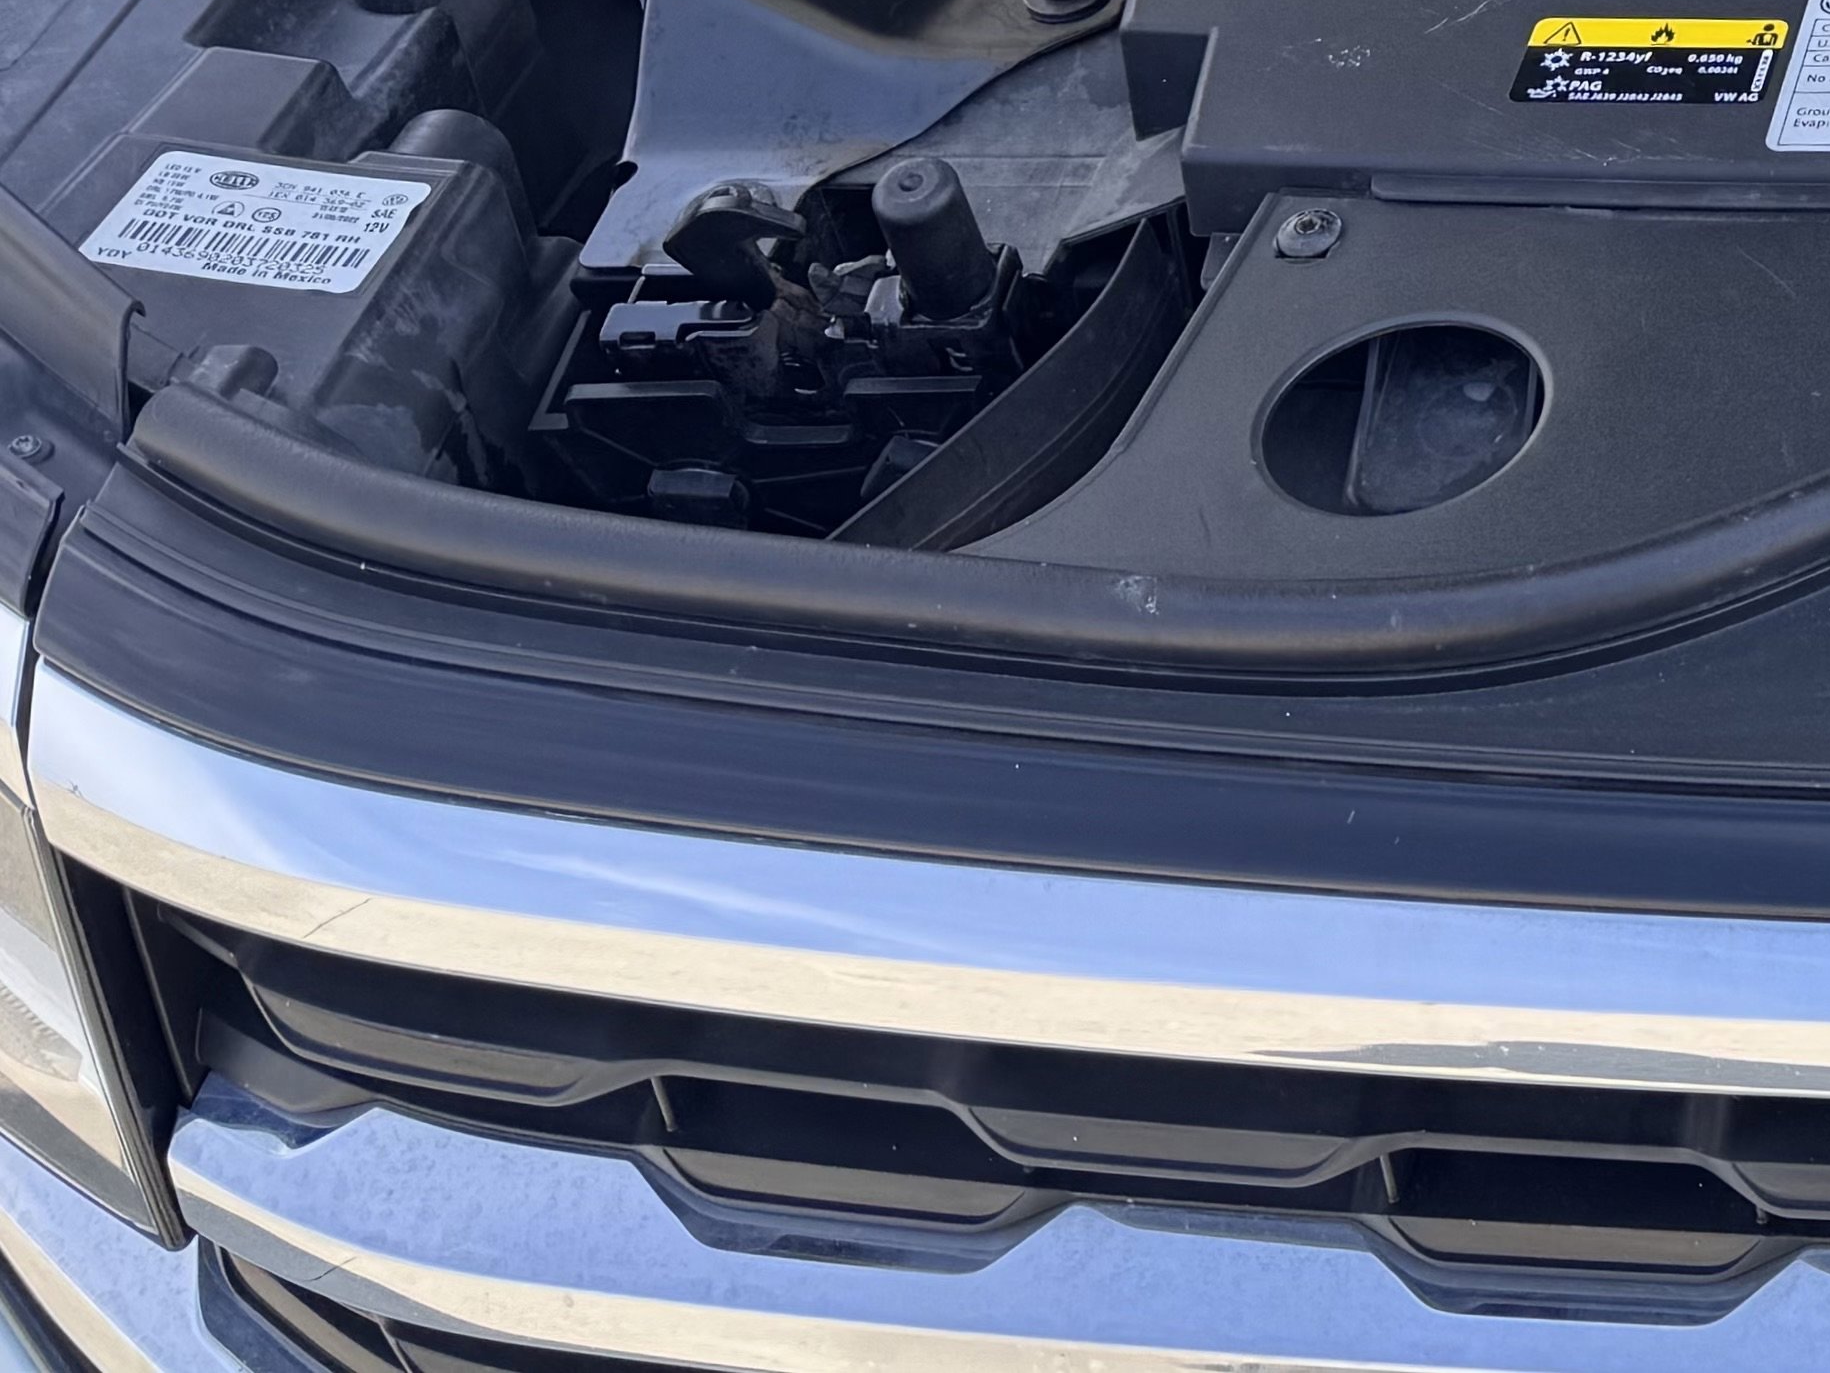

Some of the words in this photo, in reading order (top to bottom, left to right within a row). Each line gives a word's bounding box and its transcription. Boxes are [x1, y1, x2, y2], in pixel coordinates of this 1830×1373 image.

[1580, 51, 1652, 63] R-1234yf
[1725, 54, 1743, 64] kg
[1807, 74, 1826, 82] No
[1569, 80, 1601, 90] PAG
[1714, 93, 1737, 101] VW
[1739, 93, 1758, 102] AG
[1794, 119, 1830, 128] Evap:
[143, 208, 179, 219] DOT
[222, 221, 255, 231] DRL
[335, 235, 360, 243] RH
[364, 223, 389, 233] 12V
[202, 262, 247, 275] Made
[252, 268, 267, 278] in
[274, 273, 332, 284] Mexico
